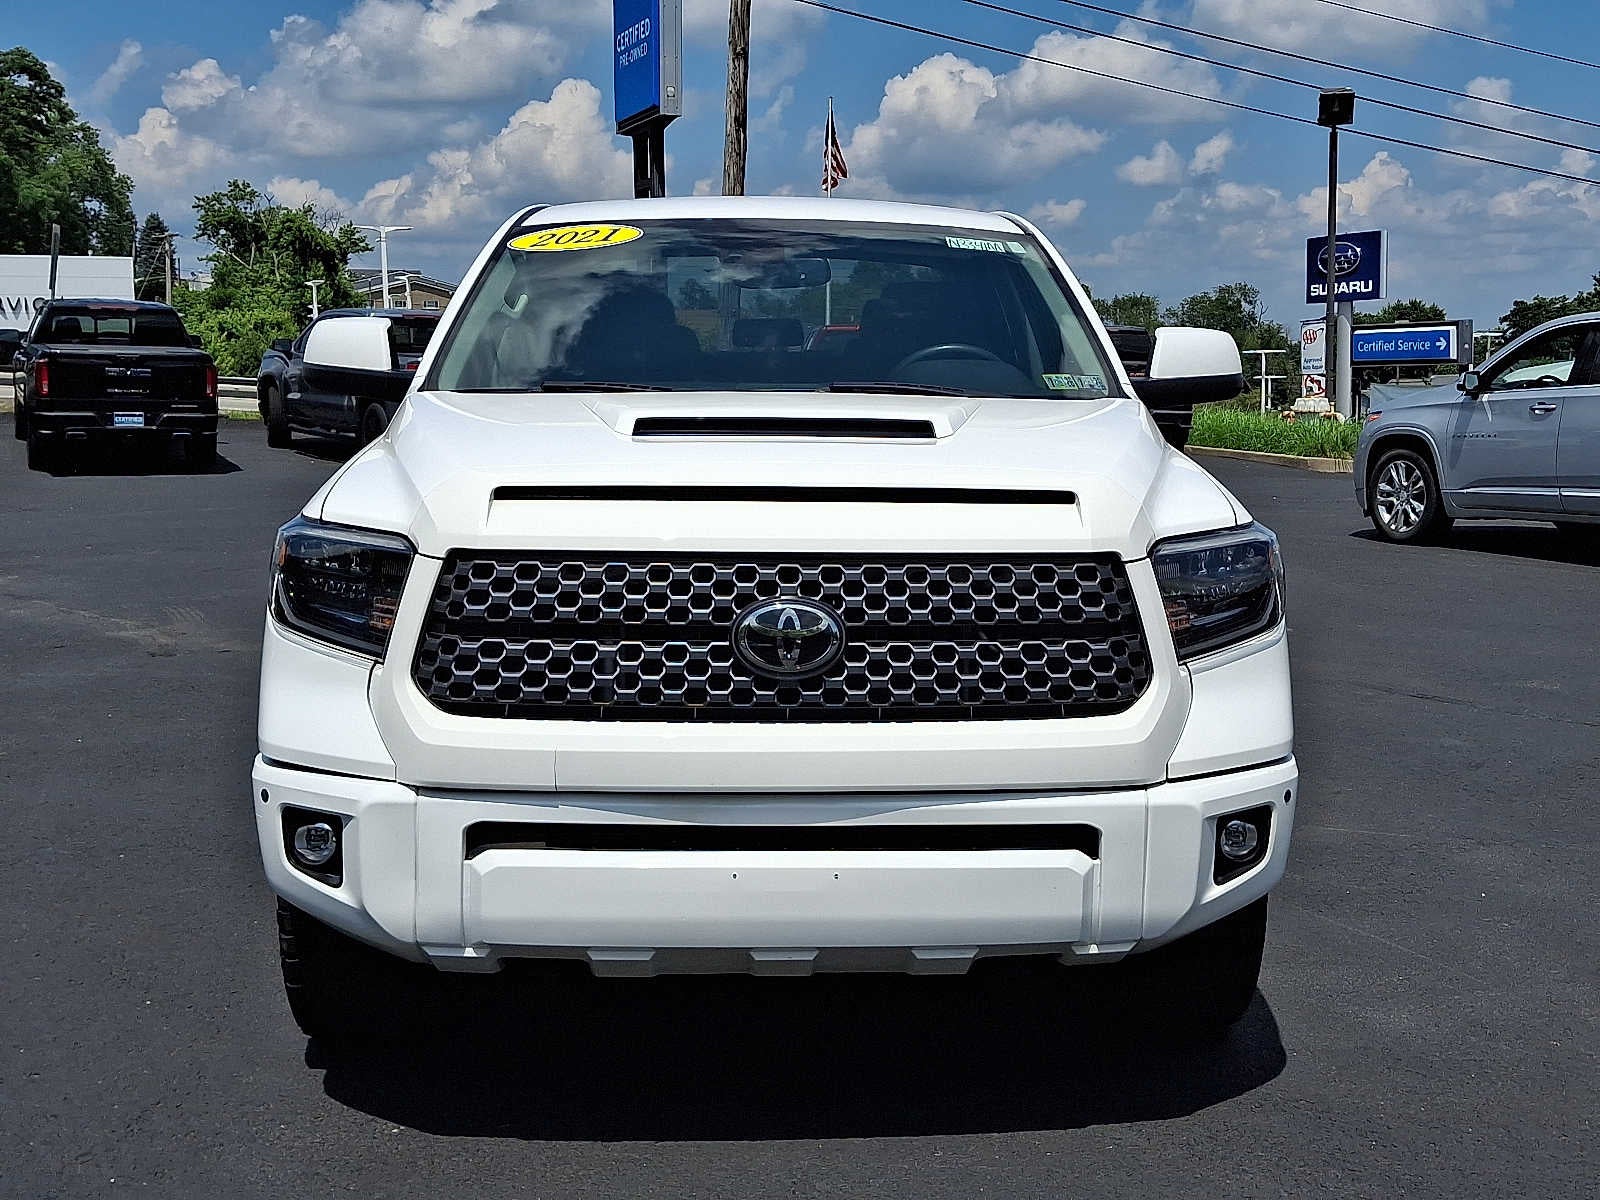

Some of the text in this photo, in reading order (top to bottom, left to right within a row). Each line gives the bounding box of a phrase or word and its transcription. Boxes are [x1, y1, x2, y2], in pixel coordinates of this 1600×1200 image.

[616, 17, 651, 53] CERTIFIED
[619, 41, 648, 70] PRE-OWNED
[529, 227, 622, 248] 2021
[1357, 339, 1431, 352] Certified Service
